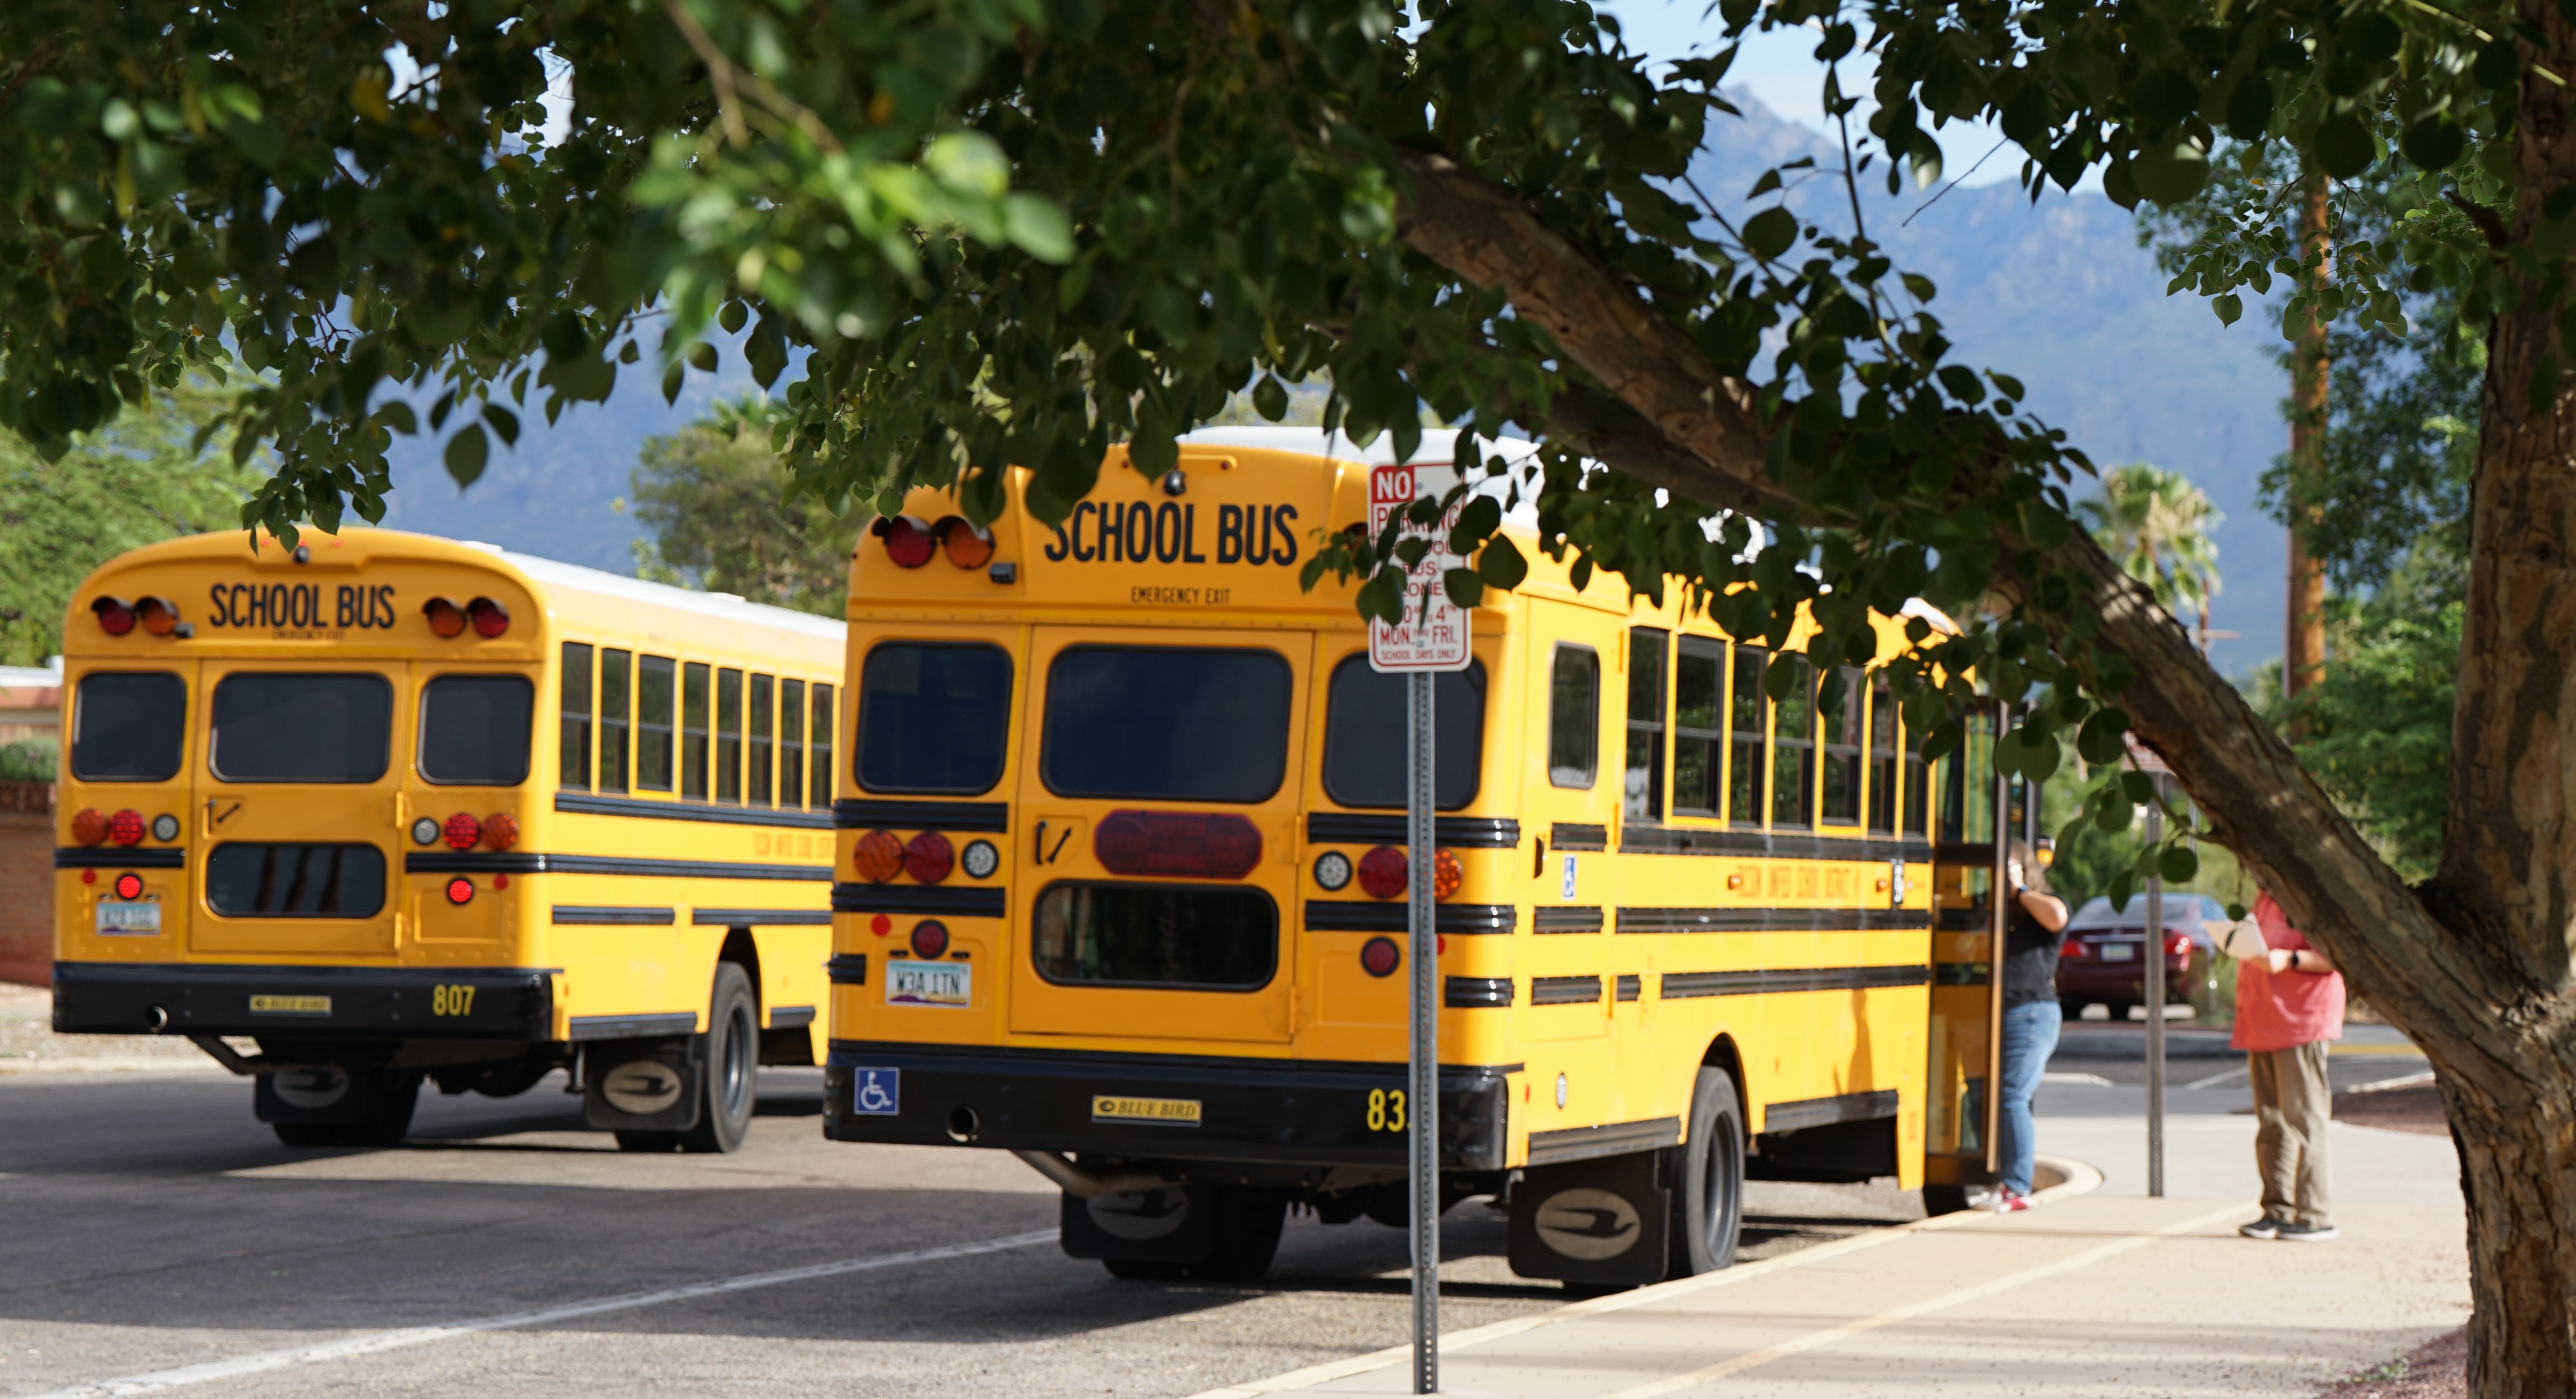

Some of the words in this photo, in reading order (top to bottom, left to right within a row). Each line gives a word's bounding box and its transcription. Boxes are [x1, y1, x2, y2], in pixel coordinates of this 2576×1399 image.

[1377, 471, 1412, 500] NO
[1218, 503, 1299, 567] BUS
[1131, 586, 1200, 604] EMERGENCY
[1205, 589, 1231, 605] EXIT
[1402, 582, 1443, 596] ONE
[210, 583, 328, 629] SCHOOL
[337, 584, 395, 629] BUS
[1436, 605, 1445, 622] 4
[1432, 625, 1458, 643] FRI.
[1381, 650, 1411, 660] SCHOOL
[1415, 649, 1434, 659] DAYS
[1437, 649, 1456, 658] ONLY
[433, 984, 476, 1016] 807
[1118, 1100, 1155, 1115] BLUE
[1160, 1103, 1196, 1117] BIRD
[1367, 1088, 1412, 1132] 83
